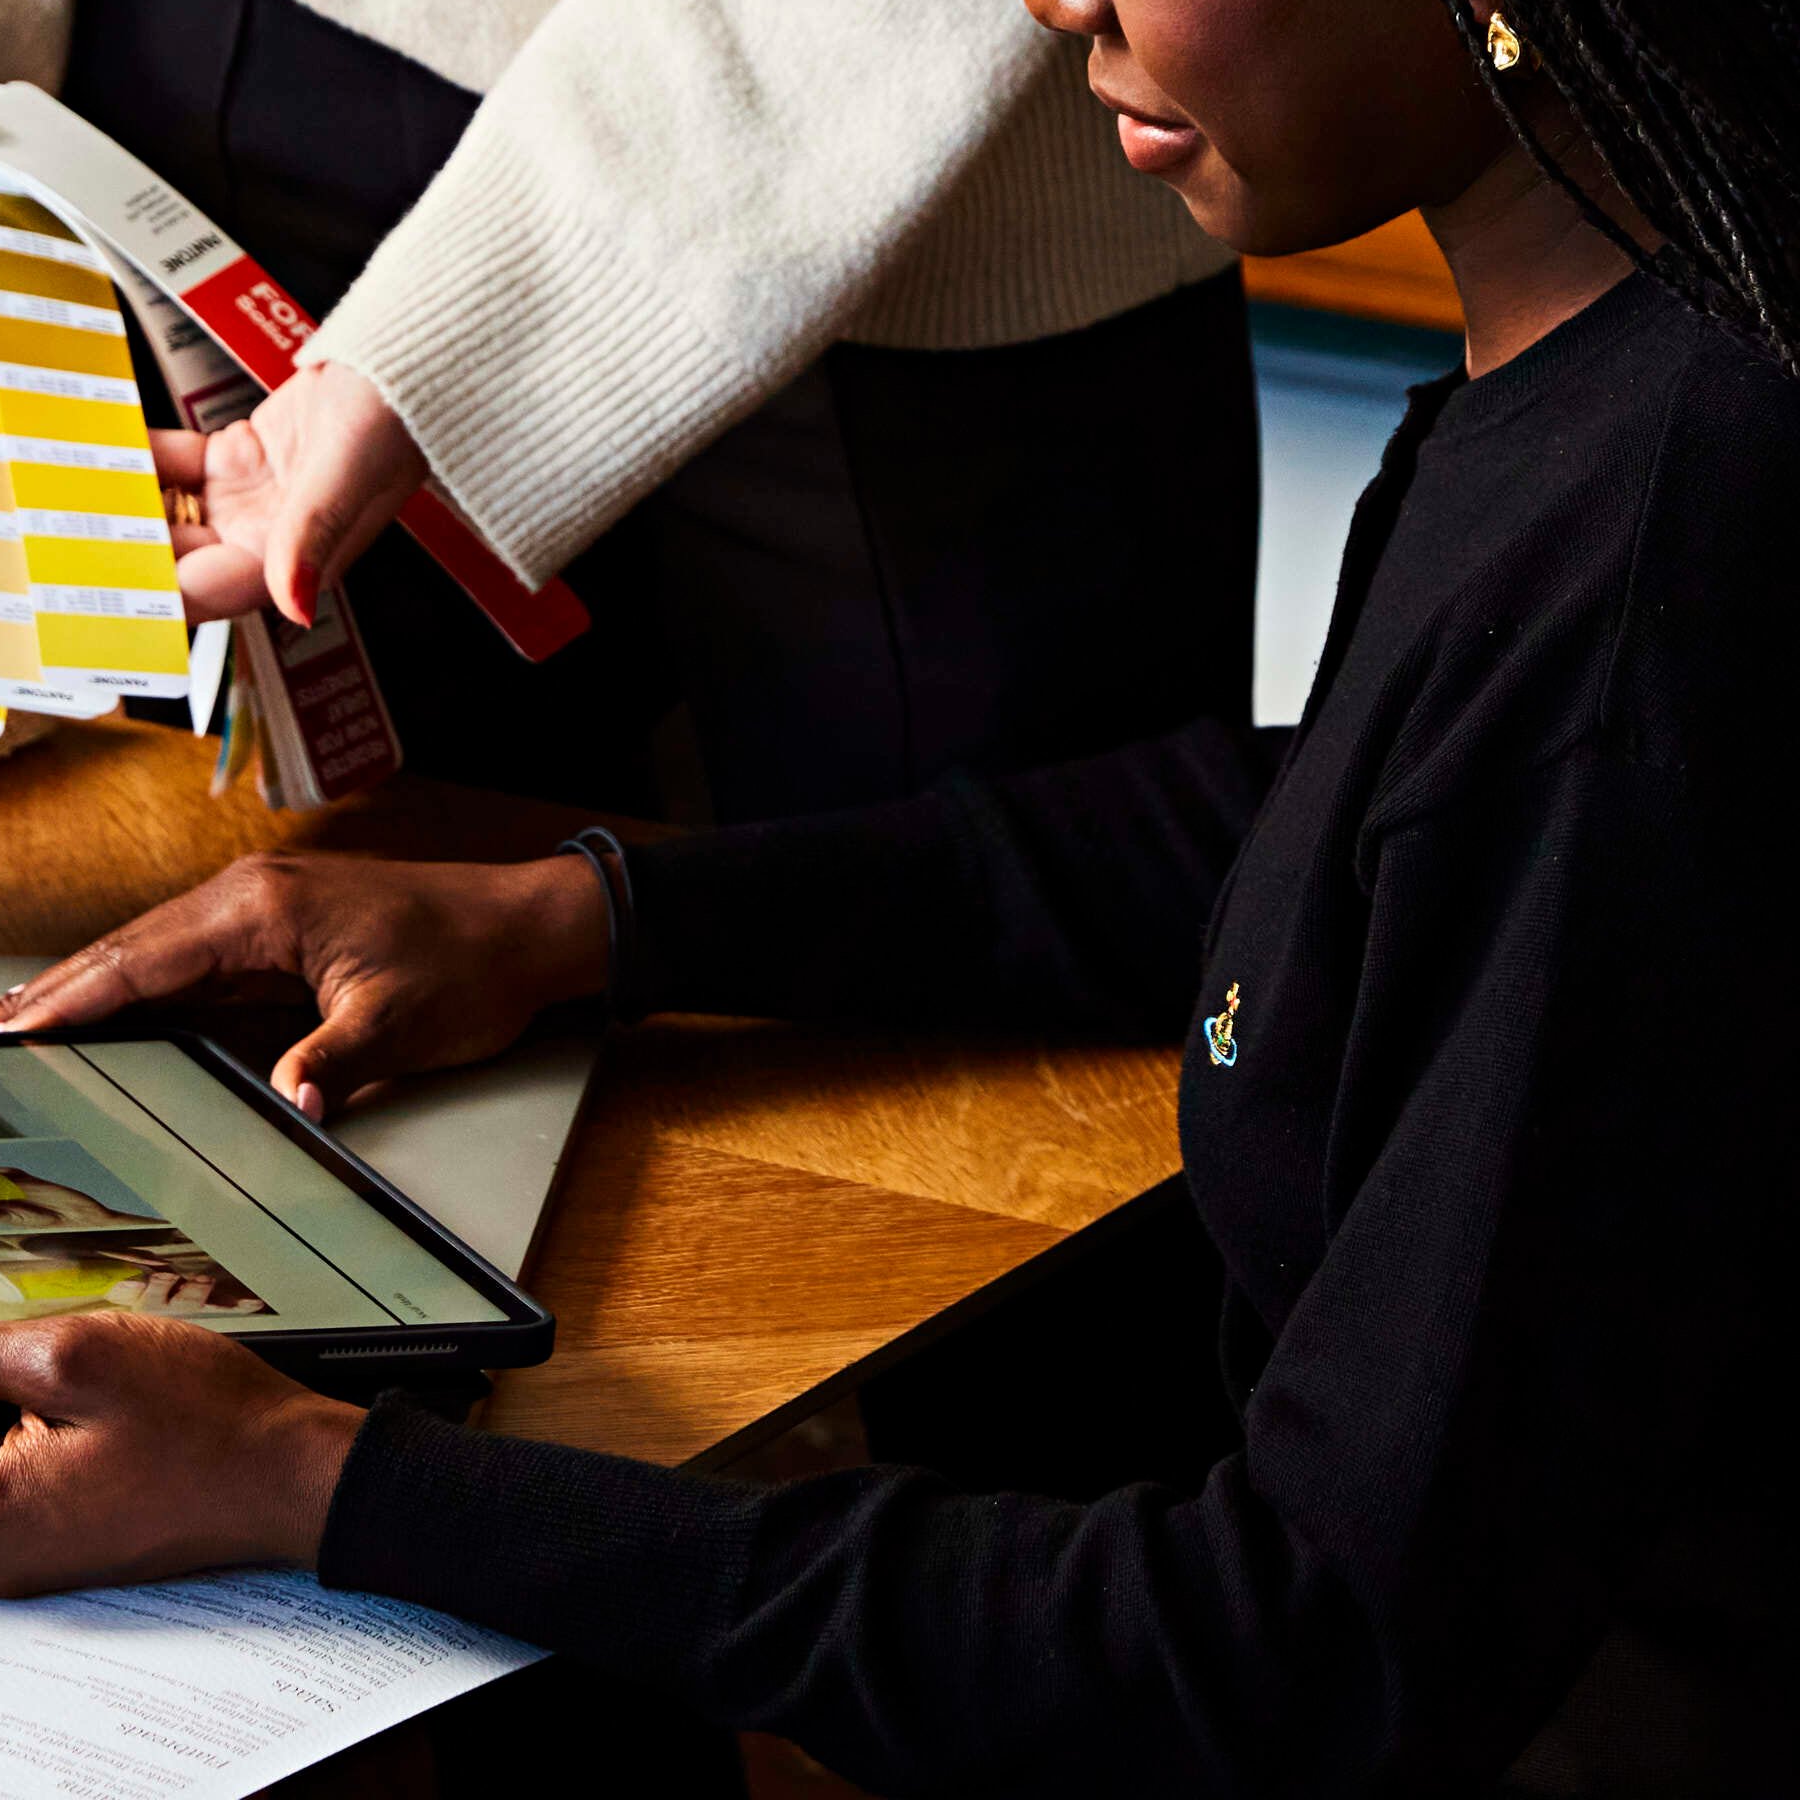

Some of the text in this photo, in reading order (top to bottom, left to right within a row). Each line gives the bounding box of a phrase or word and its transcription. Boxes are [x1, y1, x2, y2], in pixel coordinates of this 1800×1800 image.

[160, 232, 224, 273] PANTONE
[234, 293, 295, 351] Solid
[12, 685, 76, 702] PANTONE
[90, 674, 150, 689] PANTONE
[264, 1678, 344, 1714] Salads
[106, 1721, 236, 1769] Flatbreads
